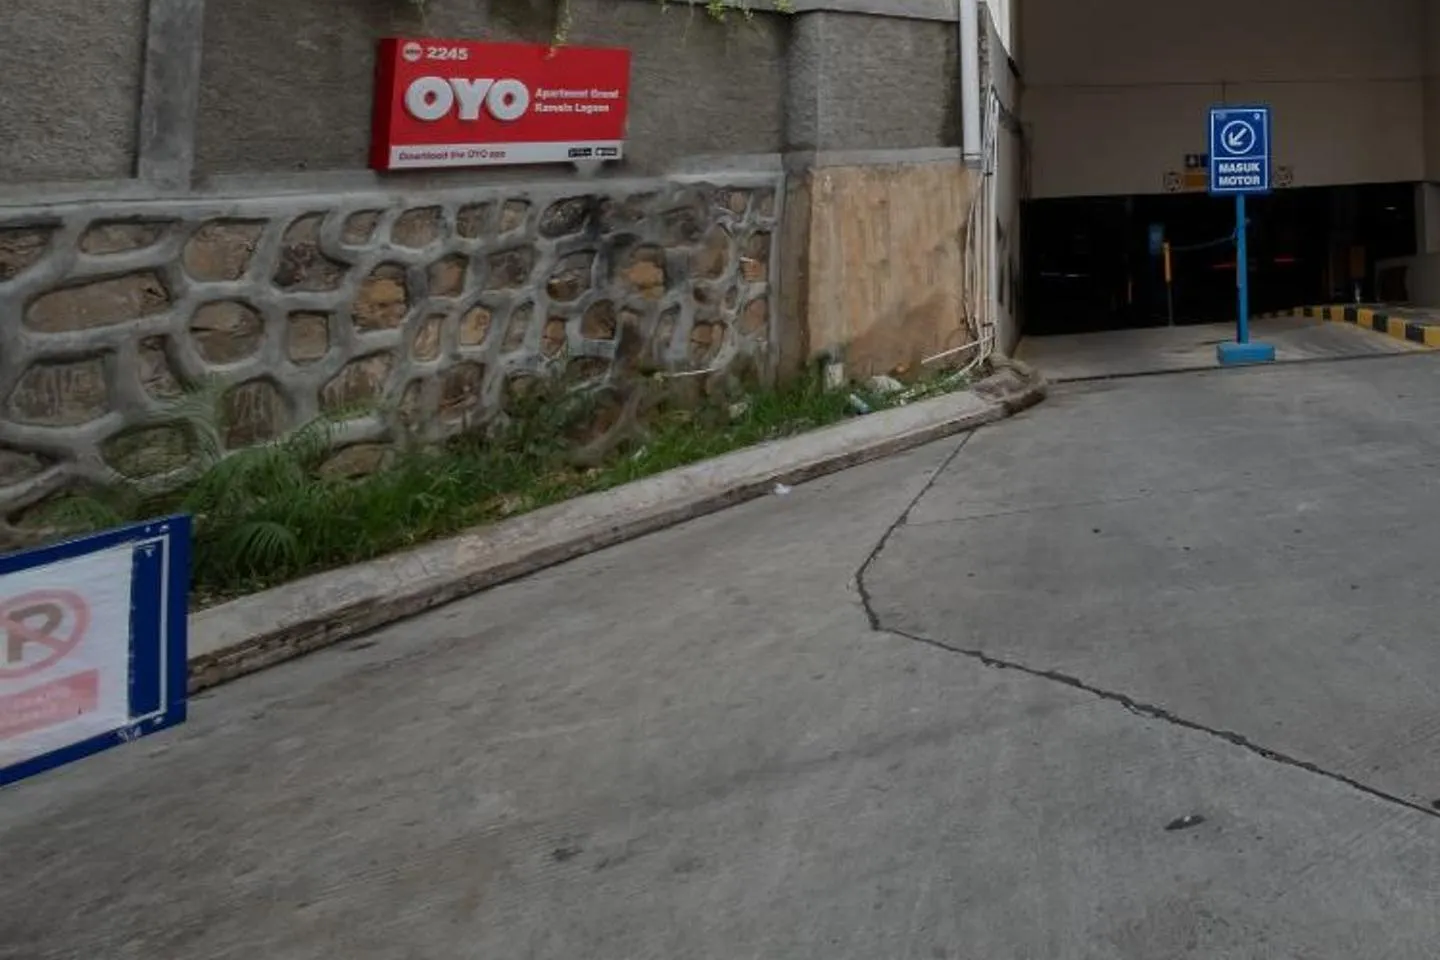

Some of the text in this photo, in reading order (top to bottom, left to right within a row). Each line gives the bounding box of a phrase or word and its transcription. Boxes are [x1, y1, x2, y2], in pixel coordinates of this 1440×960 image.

[426, 46, 469, 60] 2245
[405, 76, 529, 121] OYO
[535, 88, 588, 100] Apartment
[467, 149, 488, 159] OYO
[1218, 162, 1260, 174] MASUK
[1218, 175, 1260, 187] MOTOR
